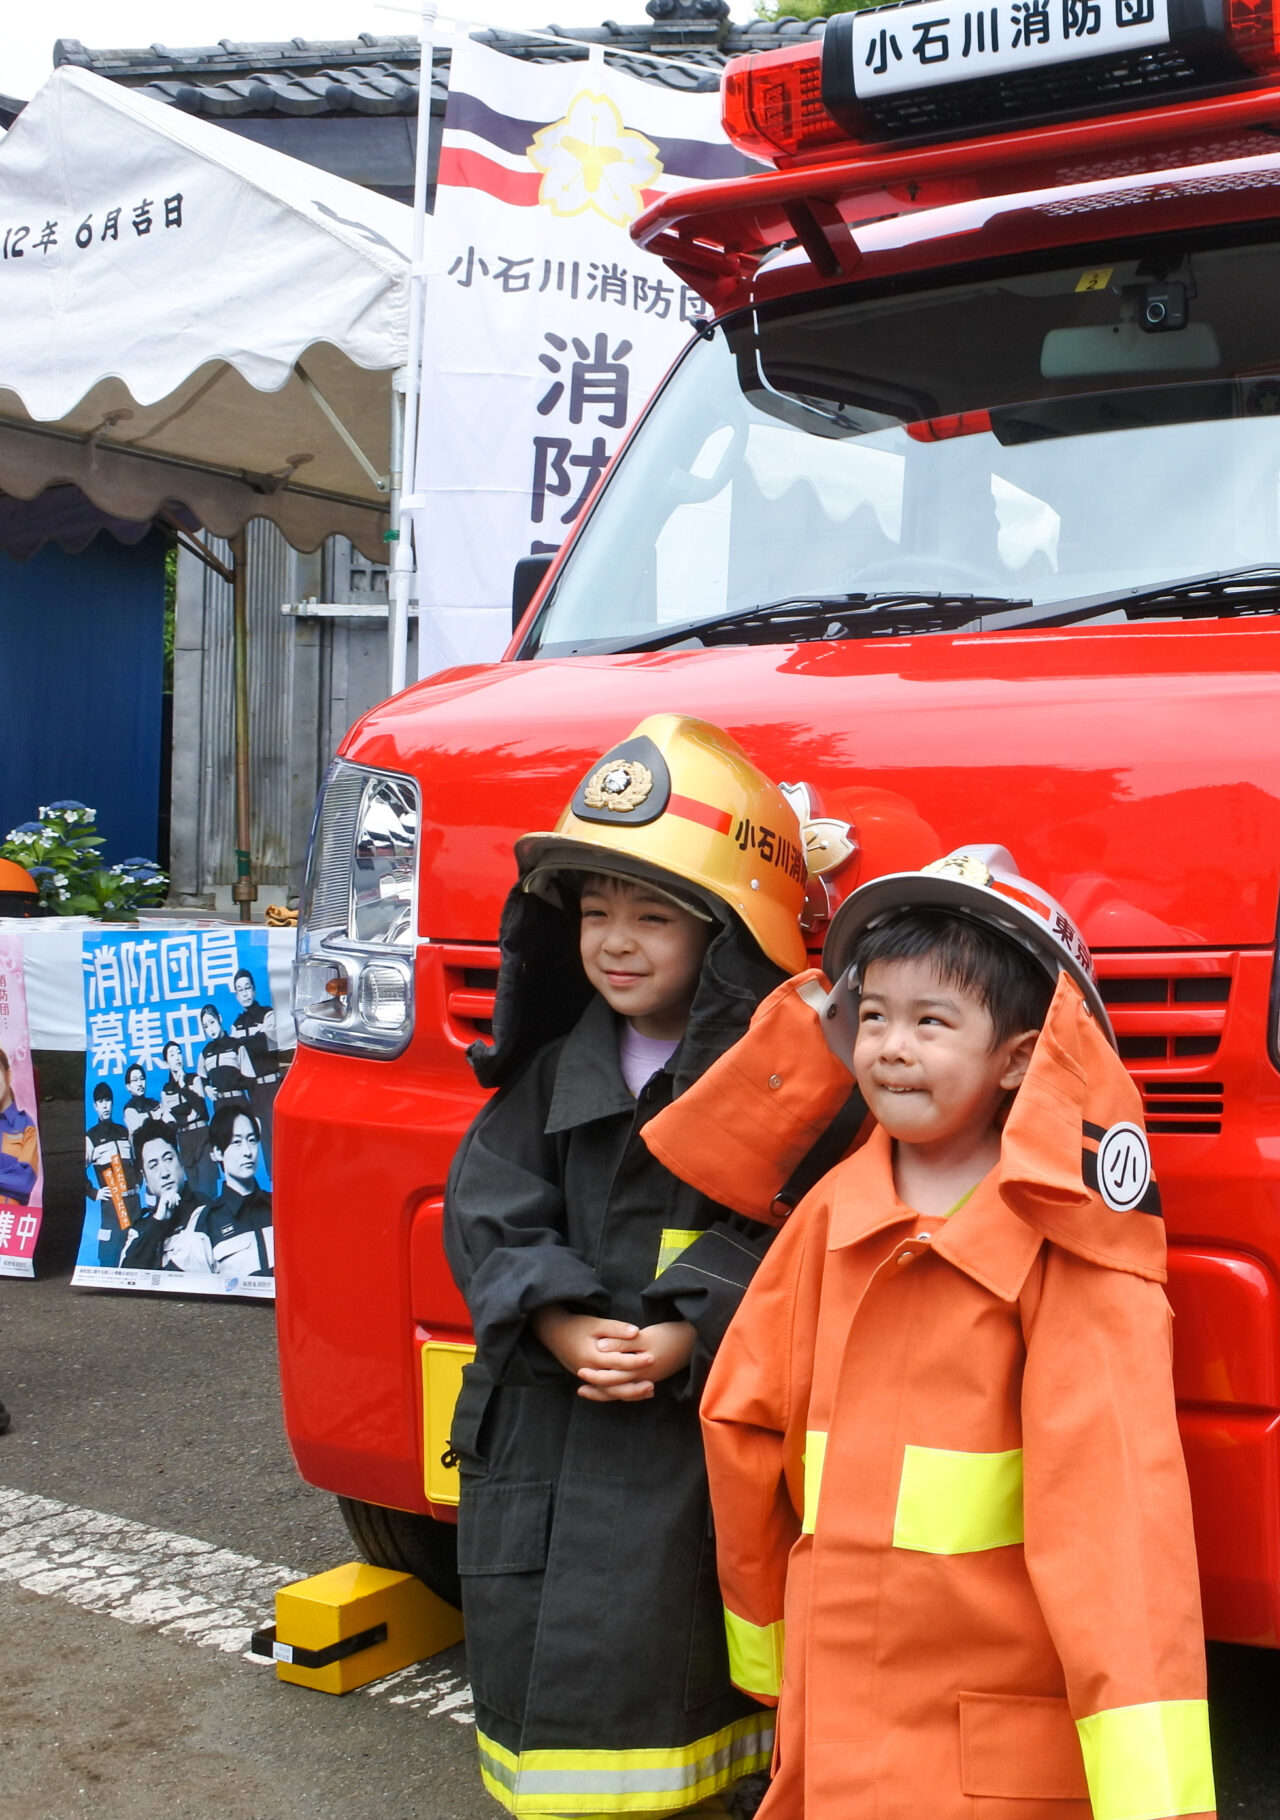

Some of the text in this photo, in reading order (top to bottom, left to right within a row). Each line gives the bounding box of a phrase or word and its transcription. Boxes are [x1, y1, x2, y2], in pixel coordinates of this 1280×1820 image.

[865, 0, 1155, 74] 小石川消防団
[447, 246, 706, 322] 小石川消防団
[530, 332, 633, 555] 消防
[735, 819, 808, 890] 小石川消
[82, 930, 239, 1010] 消防団員
[1052, 911, 1097, 984] 東京
[89, 1003, 206, 1076] 募集中
[1110, 1145, 1136, 1188] 小
